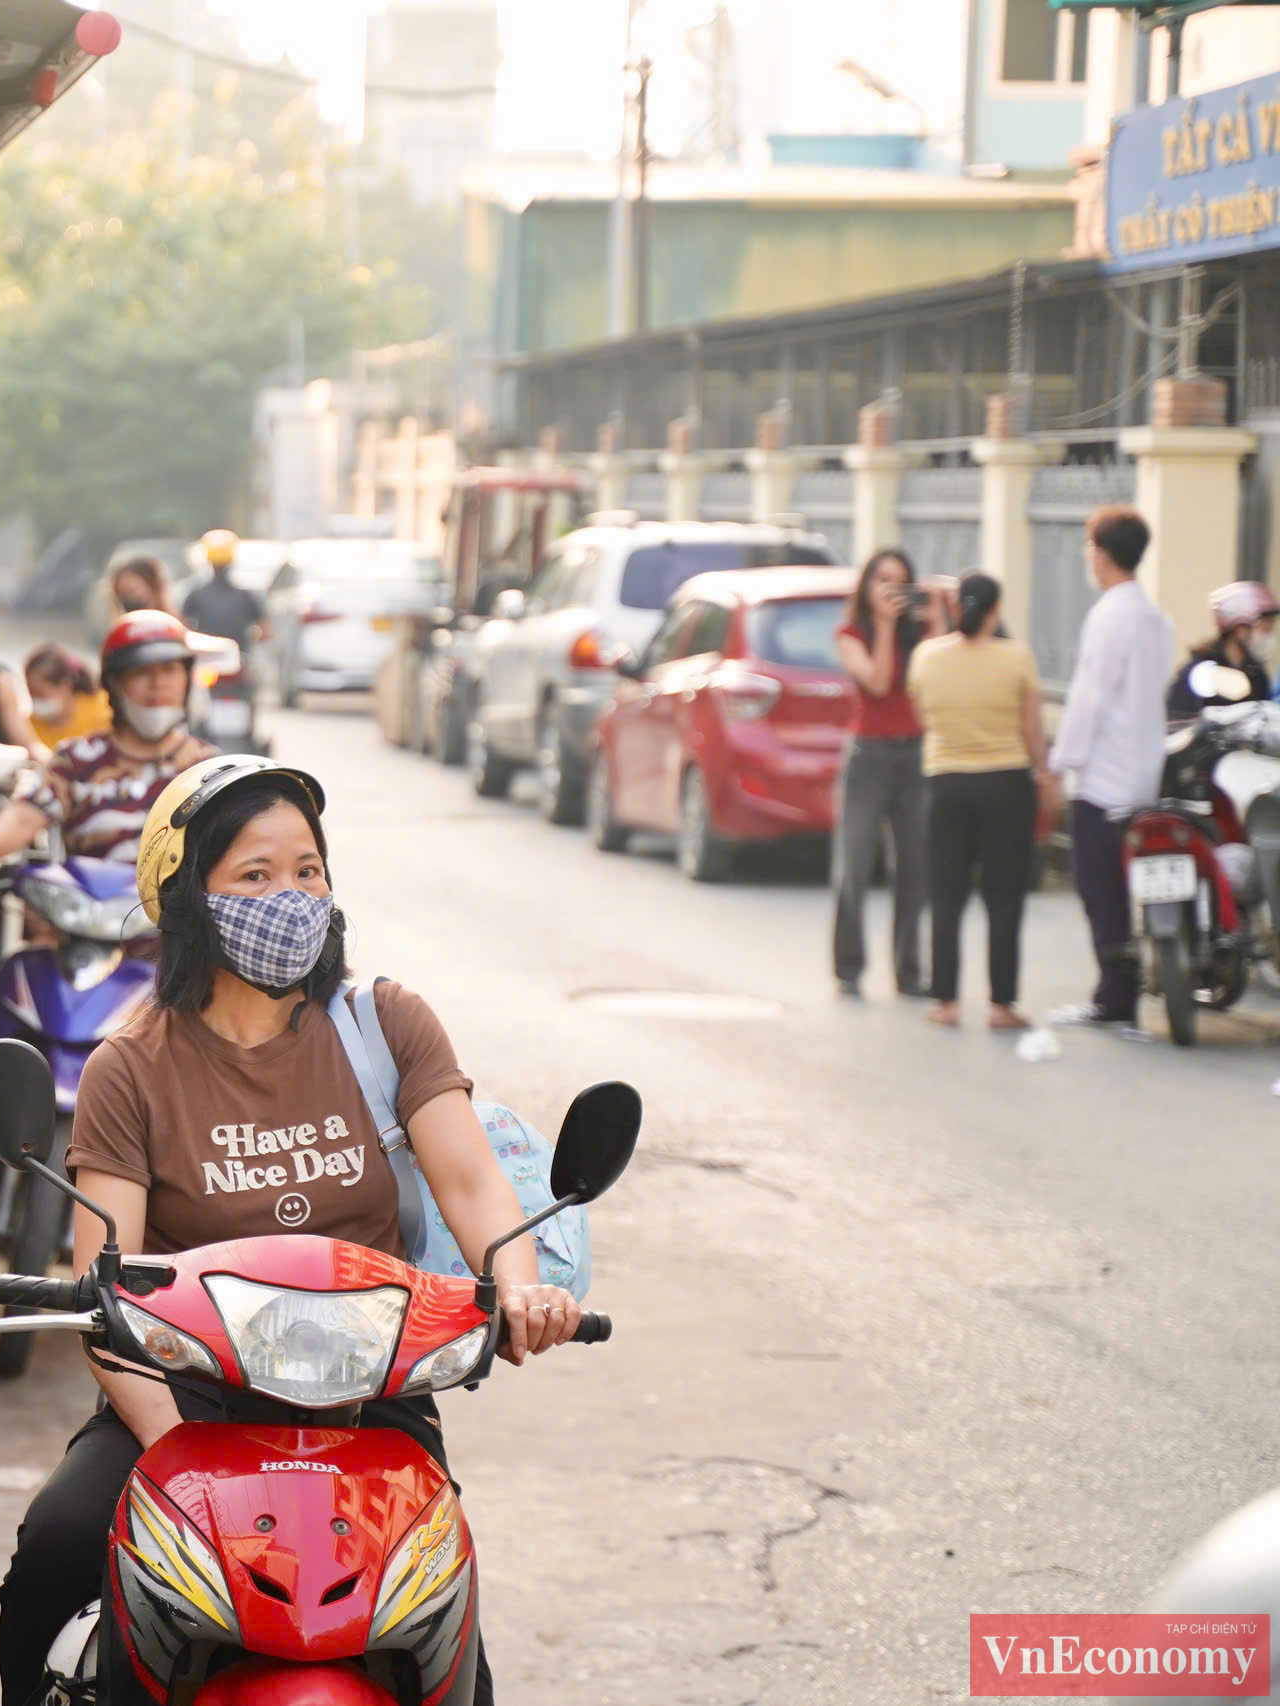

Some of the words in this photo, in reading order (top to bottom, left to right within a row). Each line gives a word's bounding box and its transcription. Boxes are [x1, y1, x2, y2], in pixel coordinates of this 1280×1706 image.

[210, 1123, 318, 1158] Have
[323, 1115, 351, 1140] a
[201, 1160, 288, 1195] Nice
[291, 1145, 366, 1187] Day
[259, 1460, 344, 1475] HONDA
